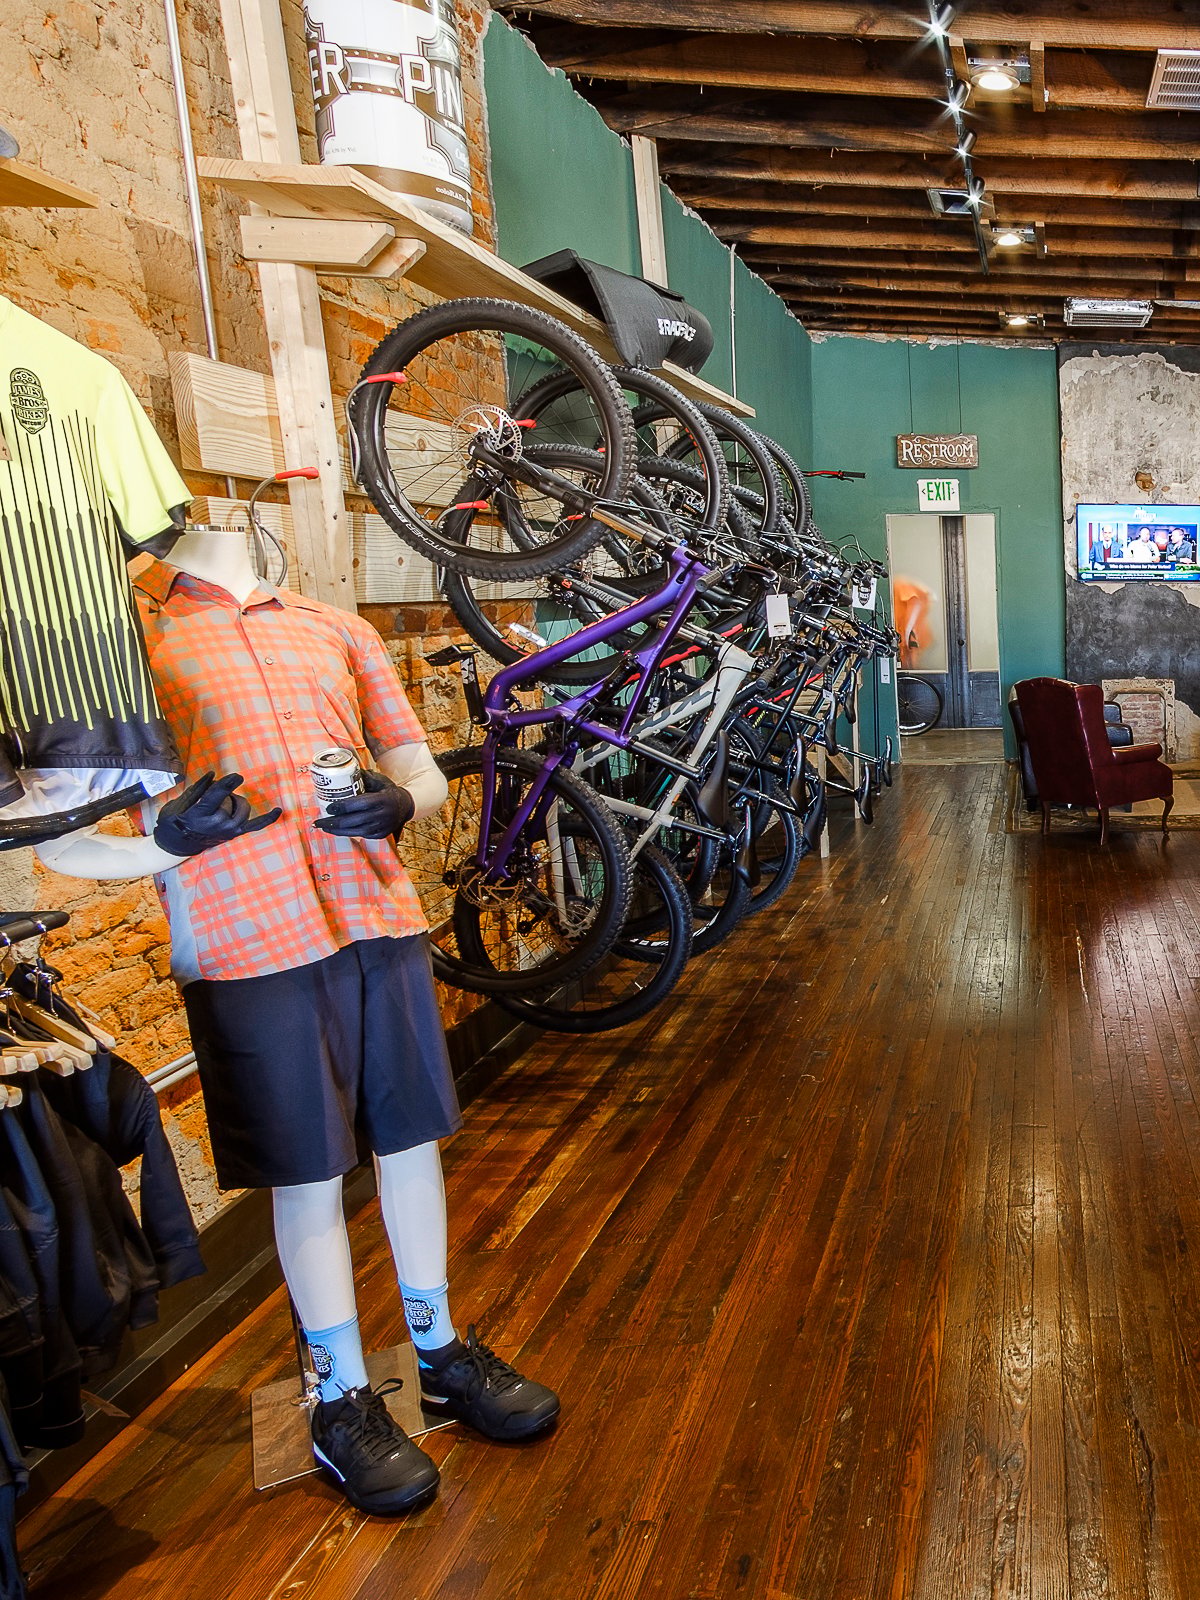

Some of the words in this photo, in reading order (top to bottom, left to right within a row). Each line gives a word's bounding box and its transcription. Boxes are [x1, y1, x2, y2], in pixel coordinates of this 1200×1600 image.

[13, 385, 41, 396] JAMES
[900, 439, 975, 465] RESTROOM
[926, 481, 952, 501] EXIT
[406, 523, 457, 558] BUTCHER
